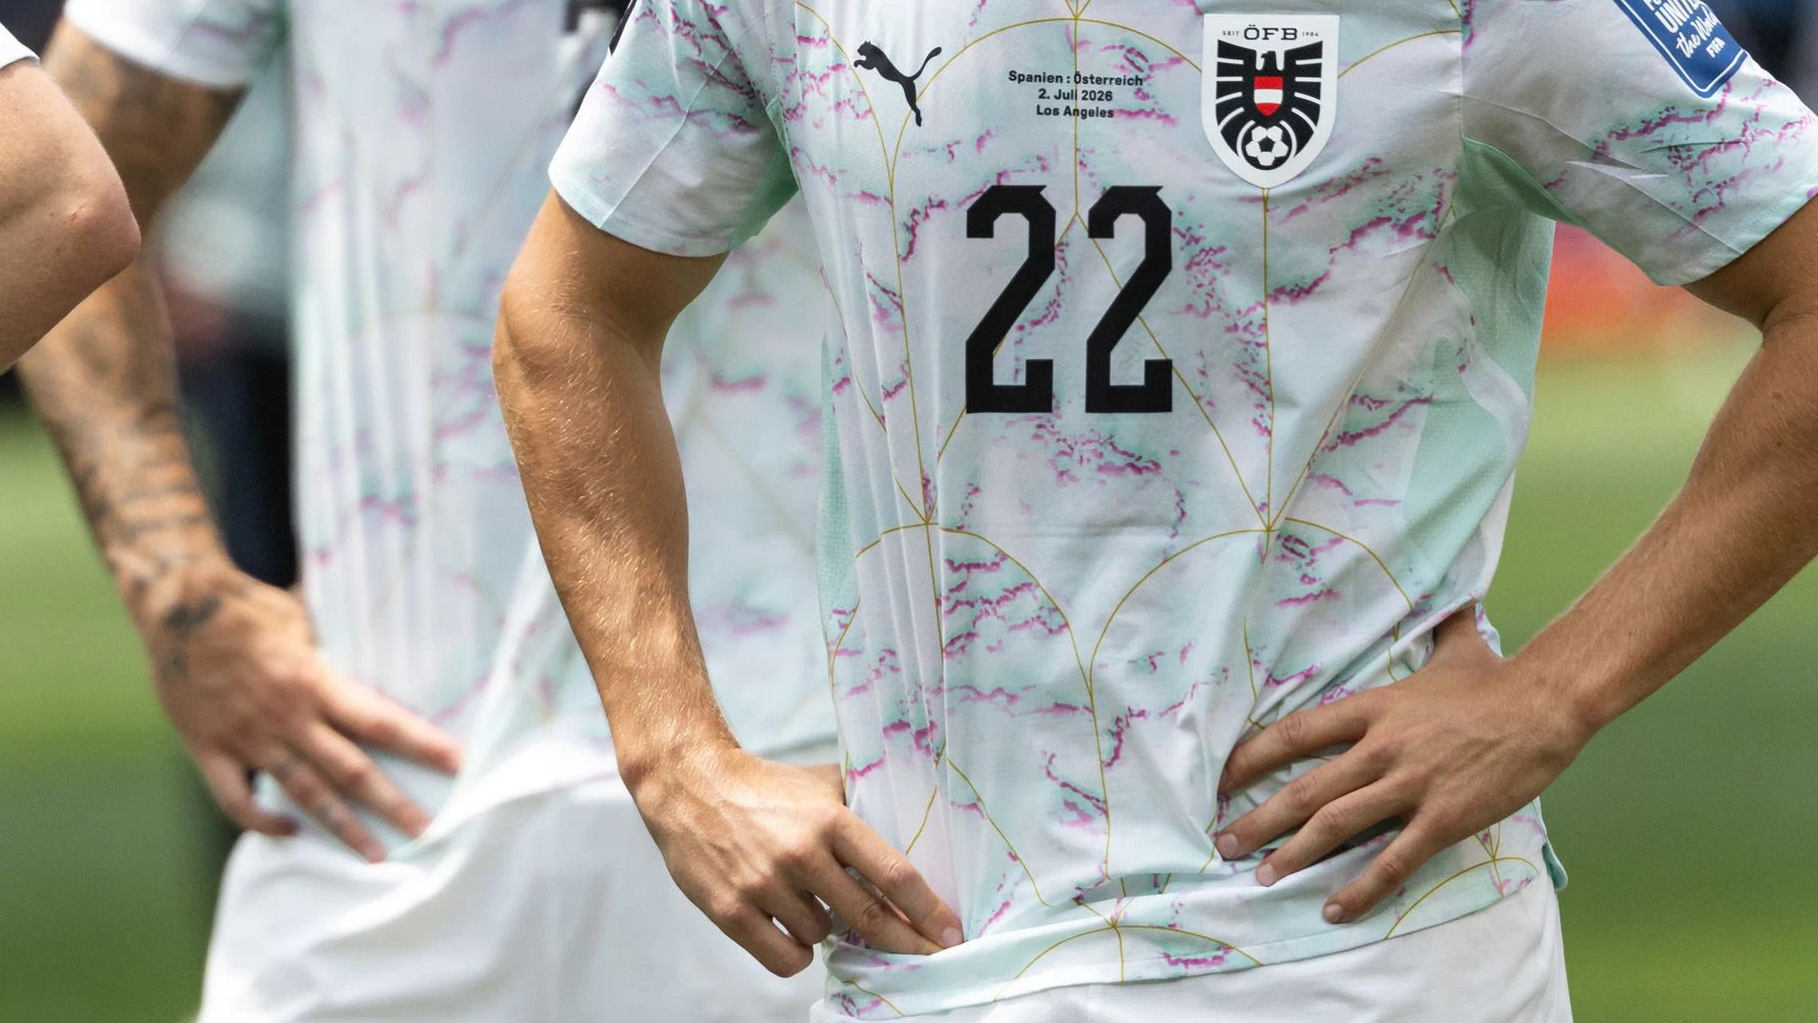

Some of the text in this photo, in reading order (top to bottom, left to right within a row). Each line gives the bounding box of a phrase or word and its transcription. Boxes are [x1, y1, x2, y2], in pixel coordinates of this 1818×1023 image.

[1244, 24, 1298, 41] ÖFB
[1676, 31, 1702, 59] the
[1705, 36, 1726, 58] FIFA
[1008, 70, 1063, 84] Spanien
[1073, 70, 1144, 86] Österreich
[1038, 88, 1114, 102] 2. Juli 2026
[1036, 104, 1115, 120] Los Angeles
[965, 185, 1173, 414] 22
